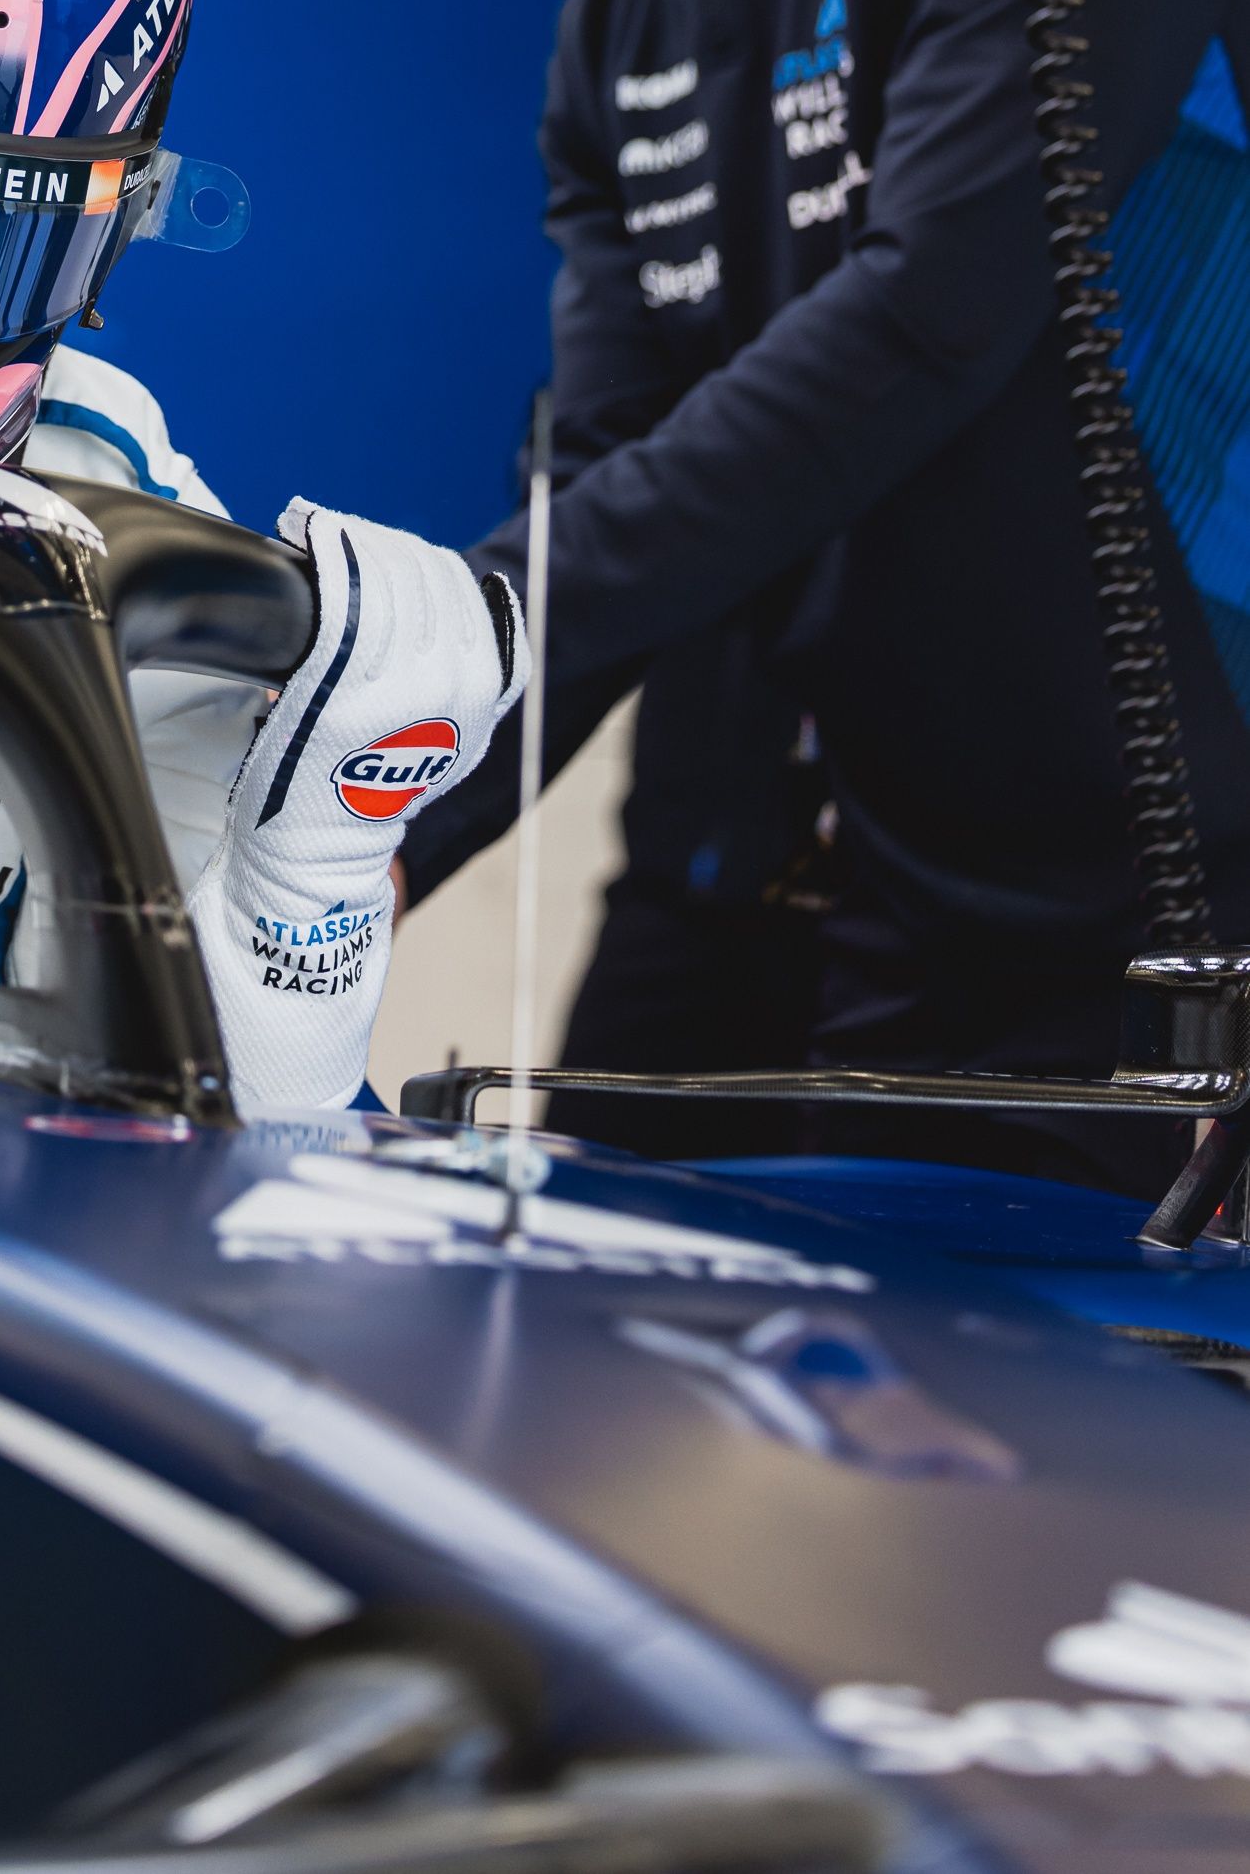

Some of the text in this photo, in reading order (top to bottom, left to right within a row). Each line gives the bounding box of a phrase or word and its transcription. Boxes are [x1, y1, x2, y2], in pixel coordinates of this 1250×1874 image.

[341, 753, 453, 783] Gulf
[256, 911, 381, 946] ATLASSIA
[253, 926, 372, 973] WILLIAMS
[263, 960, 362, 995] RACING
